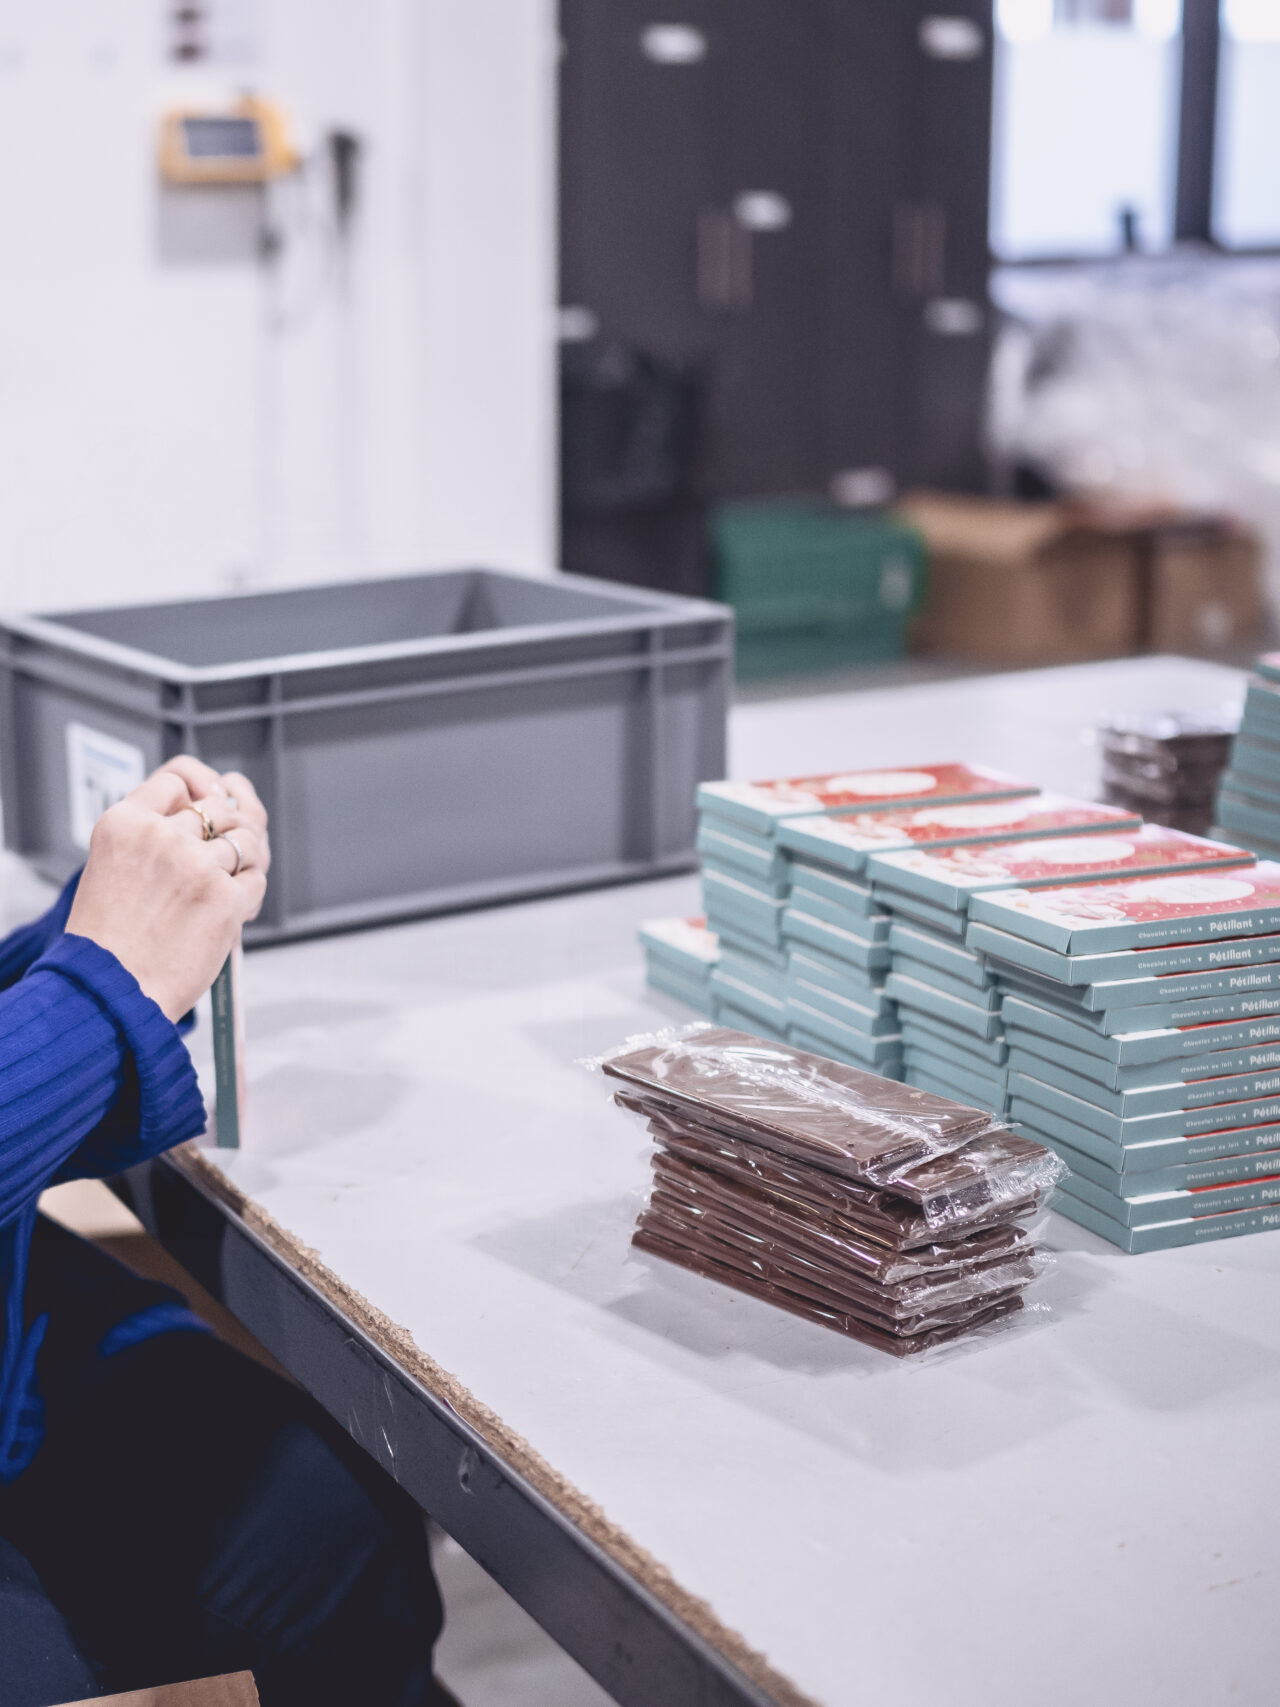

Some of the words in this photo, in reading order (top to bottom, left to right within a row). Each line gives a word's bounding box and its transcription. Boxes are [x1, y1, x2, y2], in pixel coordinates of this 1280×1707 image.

[1210, 919, 1253, 932] Pétillant
[1209, 949, 1252, 962] Pétillant
[1230, 974, 1271, 988] Pétillant
